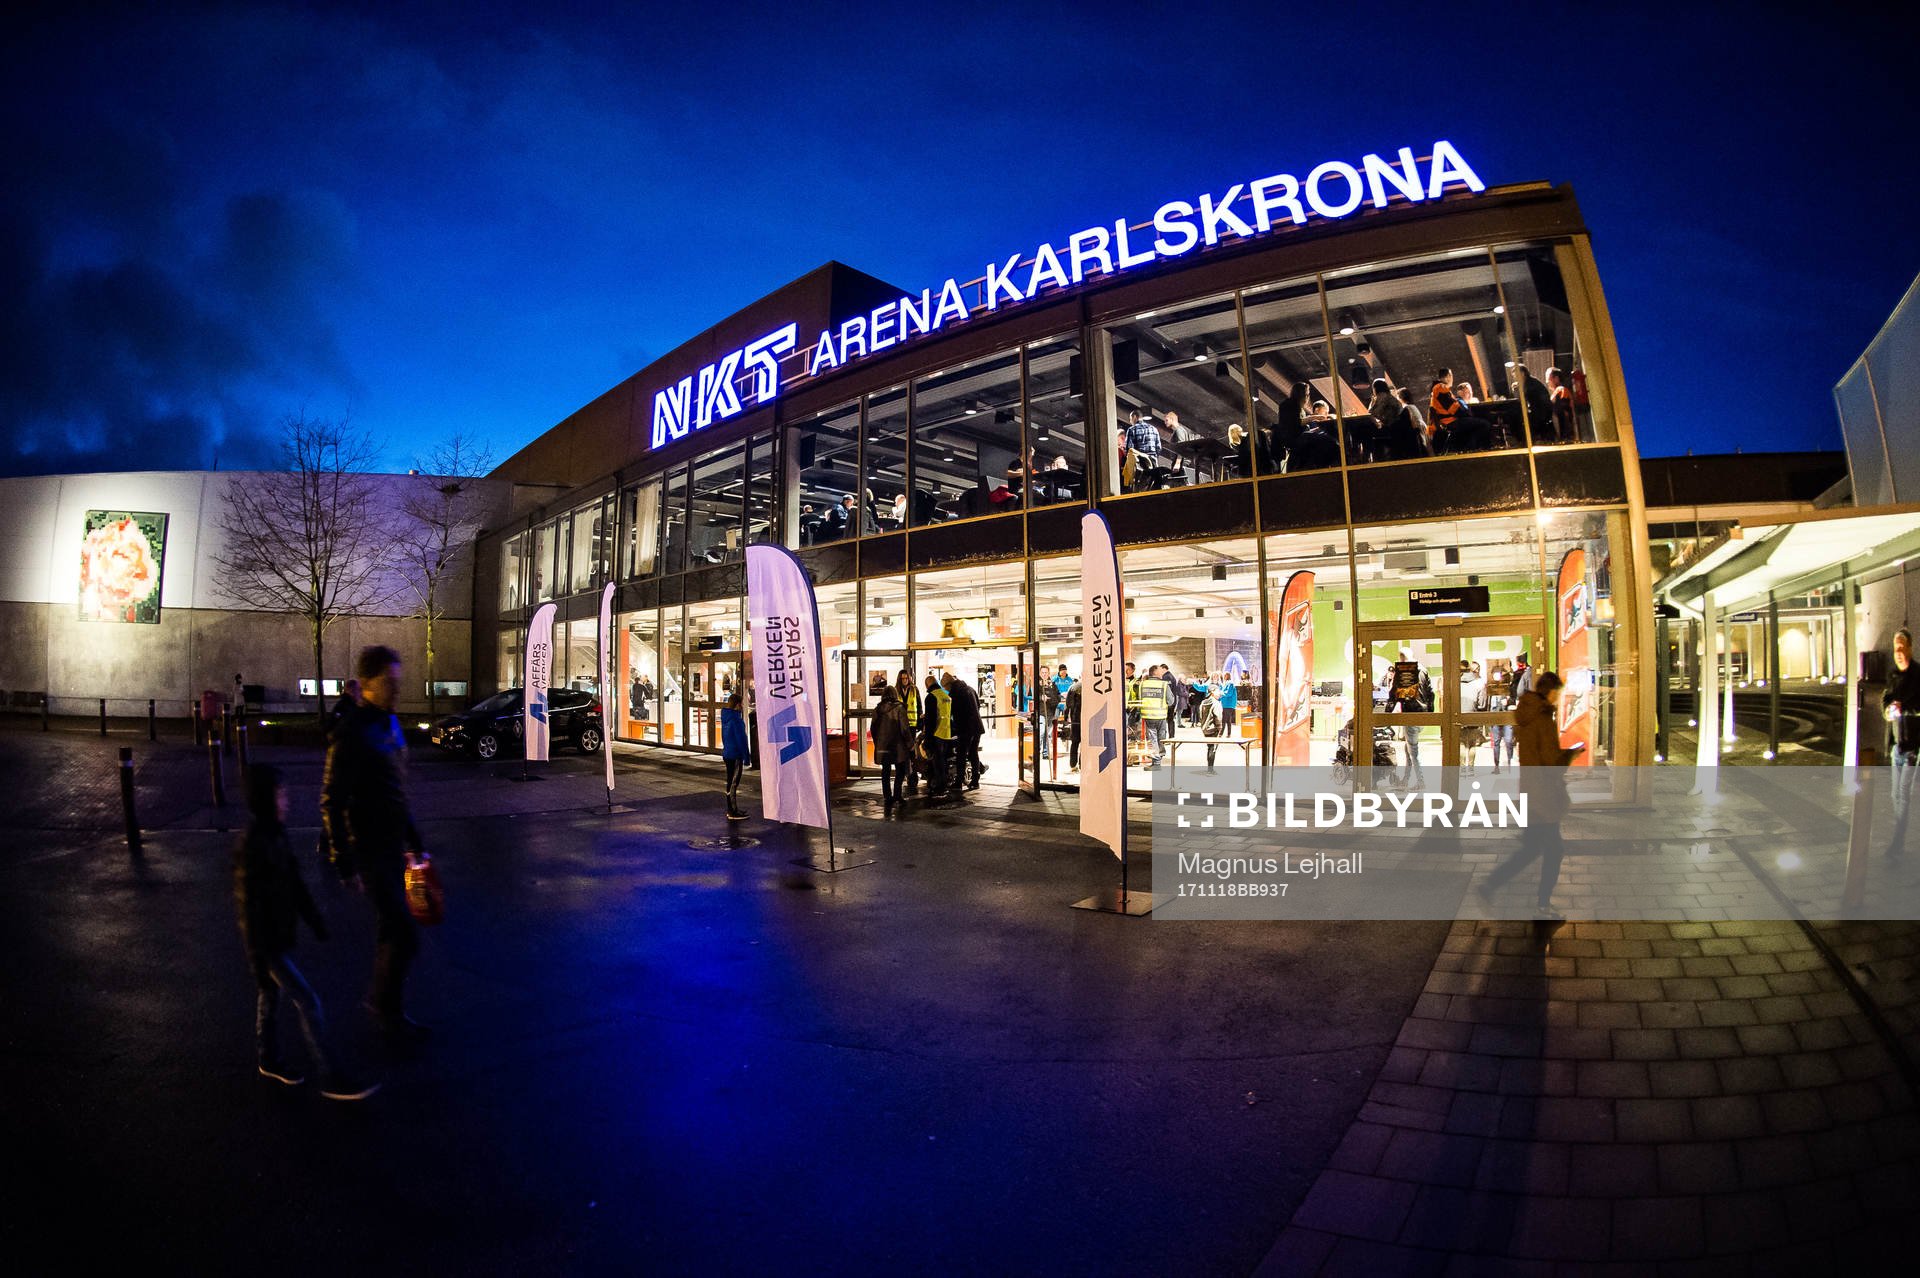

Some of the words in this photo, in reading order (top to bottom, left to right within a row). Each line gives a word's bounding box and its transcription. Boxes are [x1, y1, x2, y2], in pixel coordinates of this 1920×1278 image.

[652, 322, 797, 450] NKT
[809, 278, 969, 376] ARENA
[986, 140, 1485, 310] KARLSKRONA
[531, 643, 541, 689] AFFÄRS
